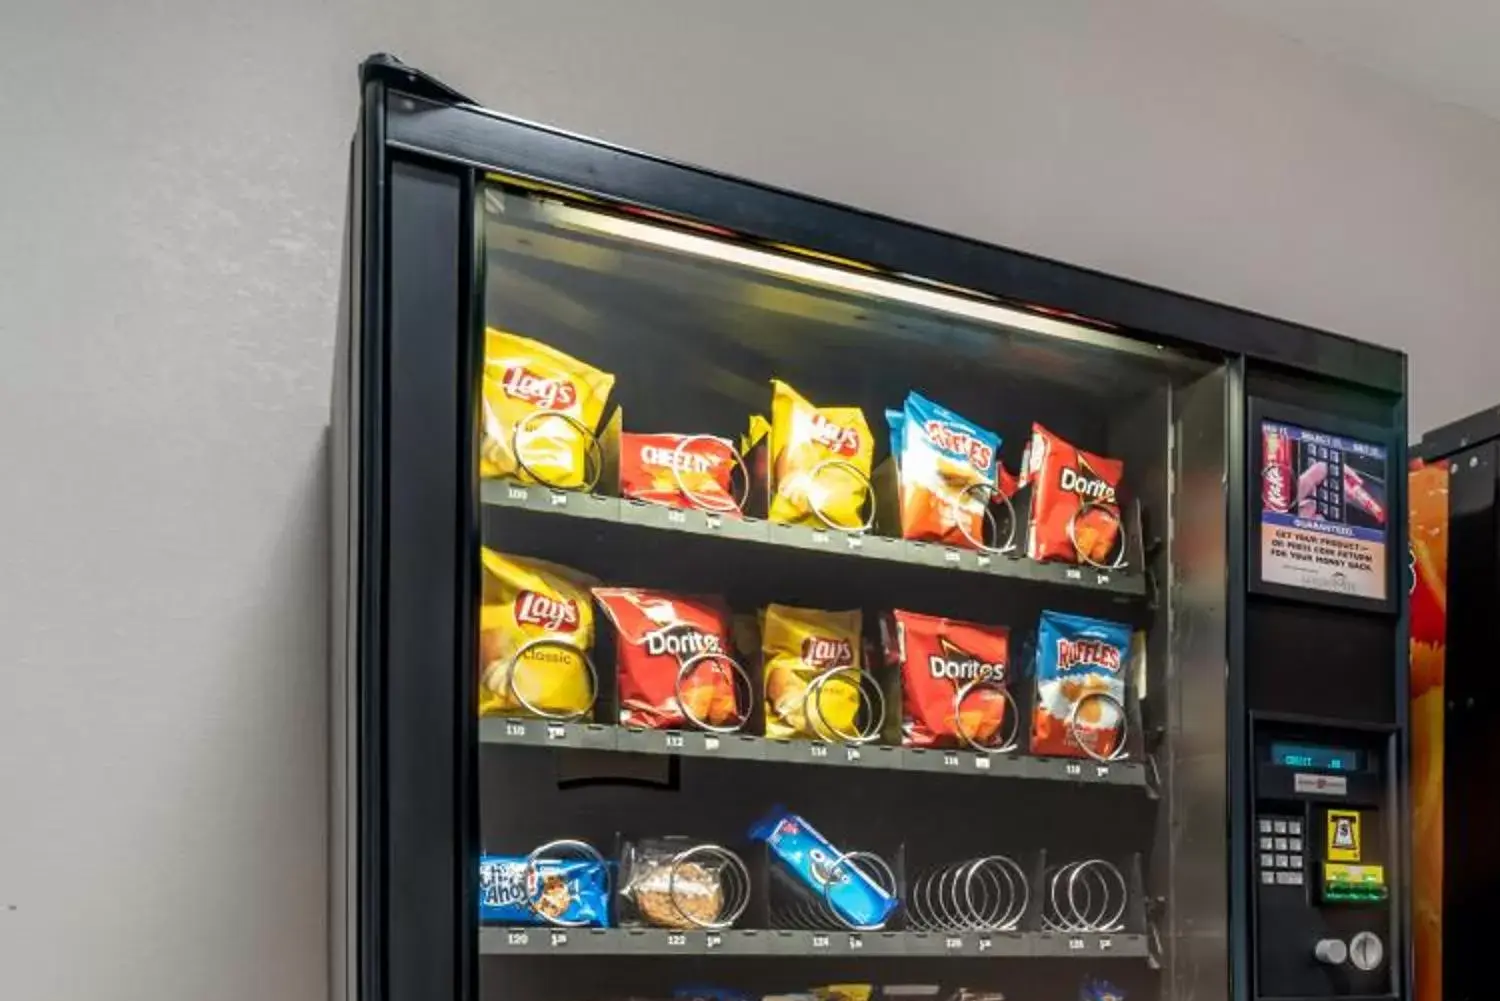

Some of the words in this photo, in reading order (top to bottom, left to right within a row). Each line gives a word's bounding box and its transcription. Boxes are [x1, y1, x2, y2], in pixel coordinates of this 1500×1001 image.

[517, 592, 577, 630] Lay's
[929, 655, 1005, 680] Doritos
[1056, 637, 1121, 671] RUFFLES
